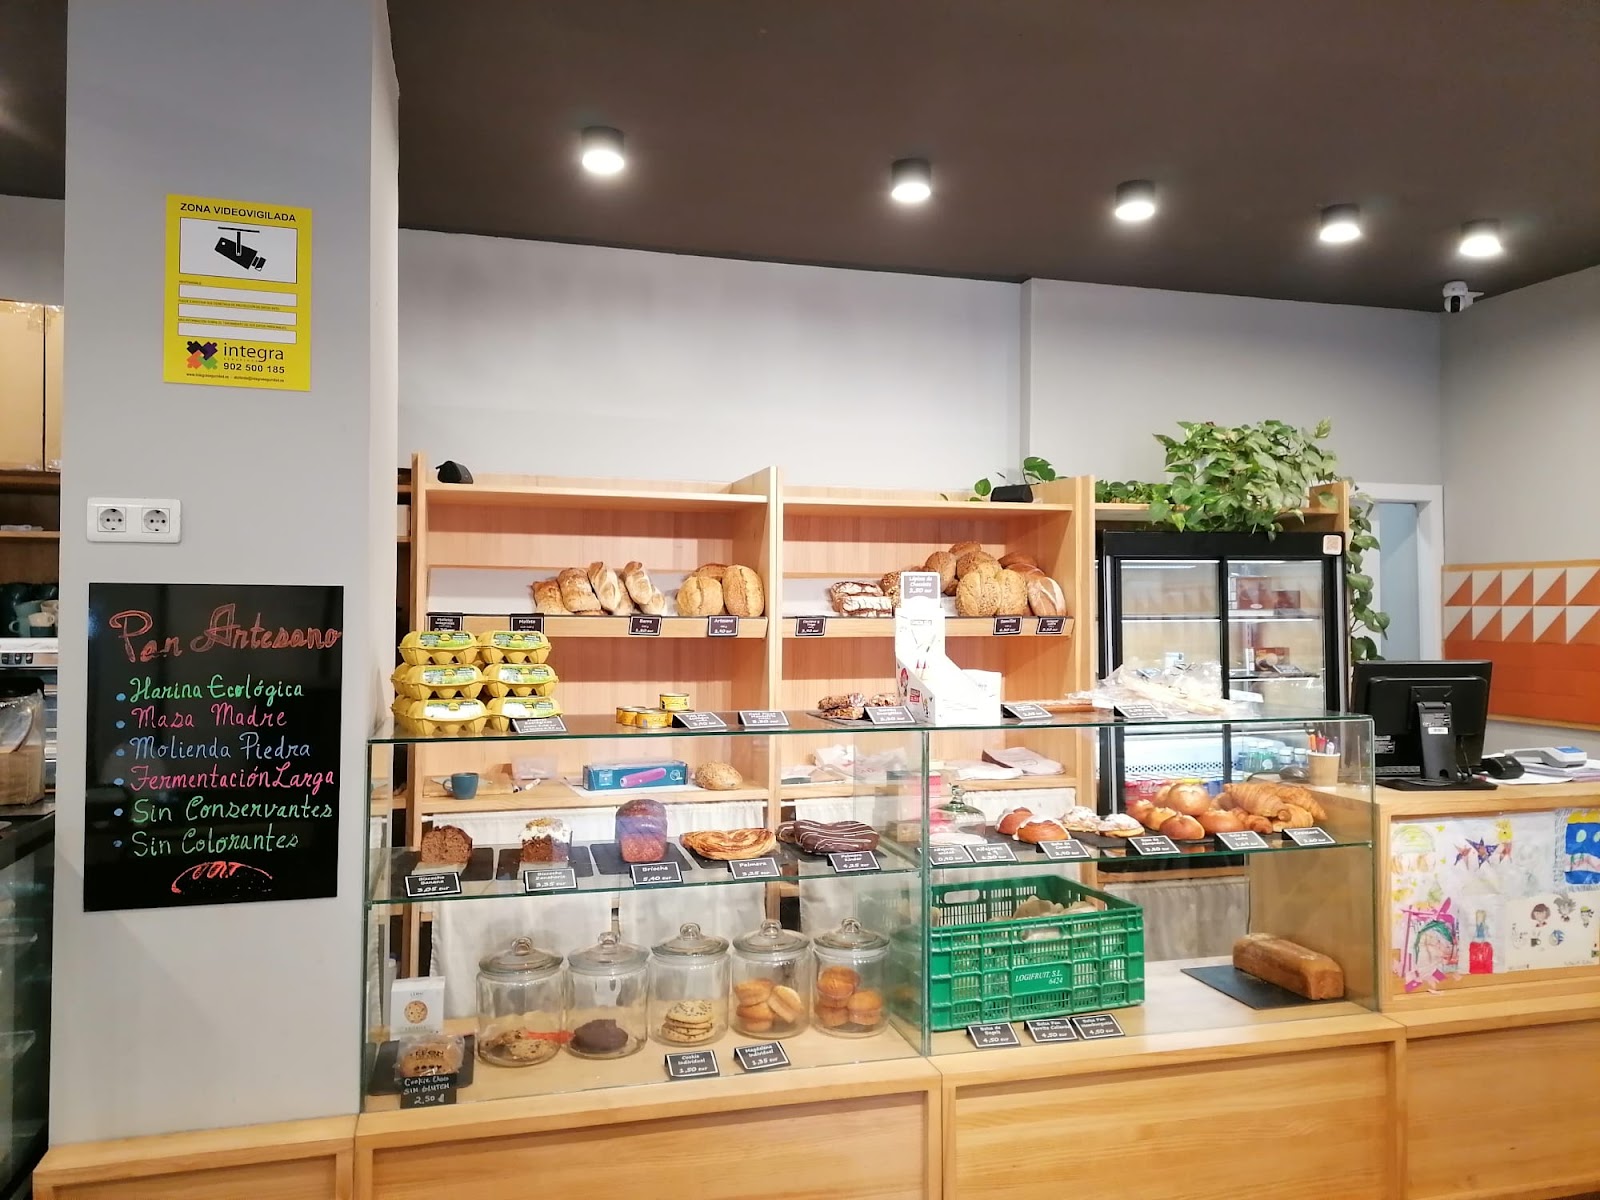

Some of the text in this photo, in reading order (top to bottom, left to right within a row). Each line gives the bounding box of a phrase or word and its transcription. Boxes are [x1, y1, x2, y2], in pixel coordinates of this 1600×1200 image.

[180, 203, 296, 222] ZONA VIDEOVIGILADA
[223, 342, 284, 363] integra
[223, 362, 285, 374] 902 500 185
[109, 603, 343, 663] Pan Artesano
[129, 673, 305, 707] Harina Ecológica
[131, 702, 288, 729] Masa Madre
[129, 731, 311, 761] Molienda Piedra
[130, 761, 335, 795] Fermentación Larga
[131, 794, 333, 824] Sin Conservantes
[131, 823, 300, 857] Sin Colorantes
[422, 1082, 450, 1093] GLUTEN
